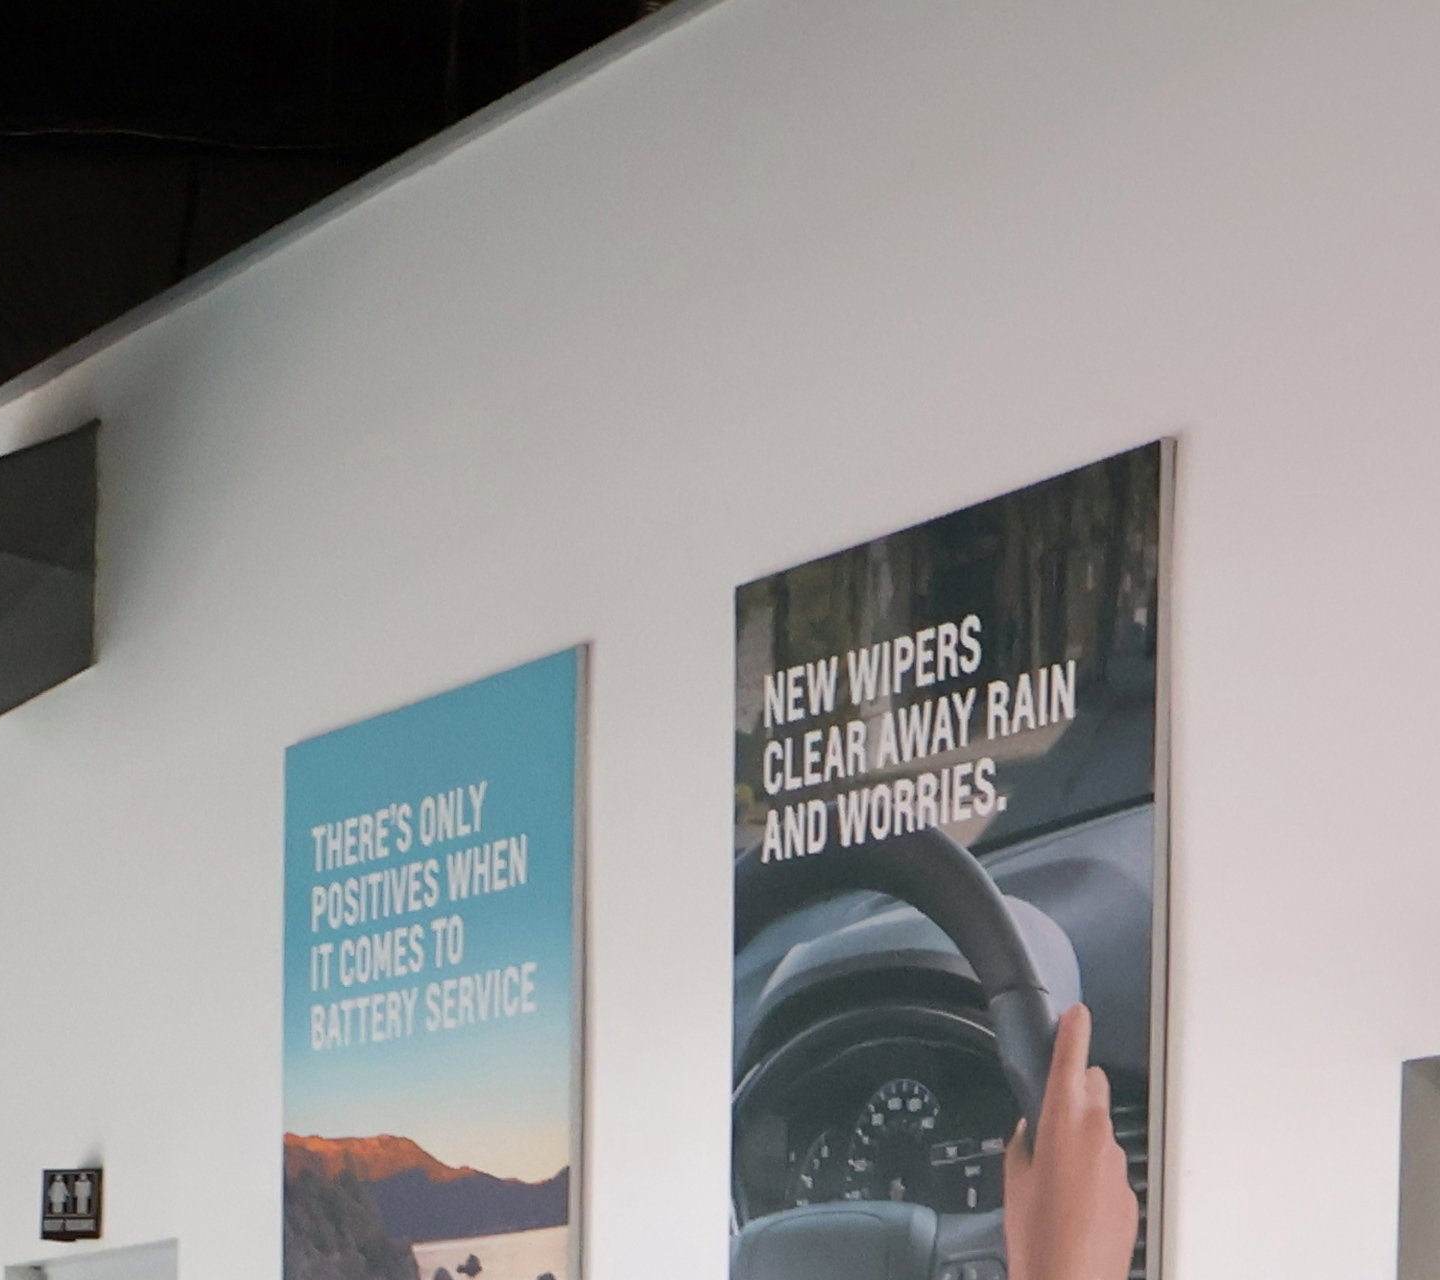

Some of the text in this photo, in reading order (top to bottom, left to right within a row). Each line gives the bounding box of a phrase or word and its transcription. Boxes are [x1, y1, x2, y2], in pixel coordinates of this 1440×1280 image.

[764, 614, 982, 729] NEW WIPERS
[763, 660, 1076, 794] CLEAR AWAY RAIN
[311, 780, 488, 871] THERE'S ONLY
[760, 756, 1007, 864] AND WORRIES.
[311, 833, 528, 932] POSITIVES WHEN
[311, 914, 464, 991] IT COMES TO
[311, 961, 538, 1051] BATTERY SERVICE
